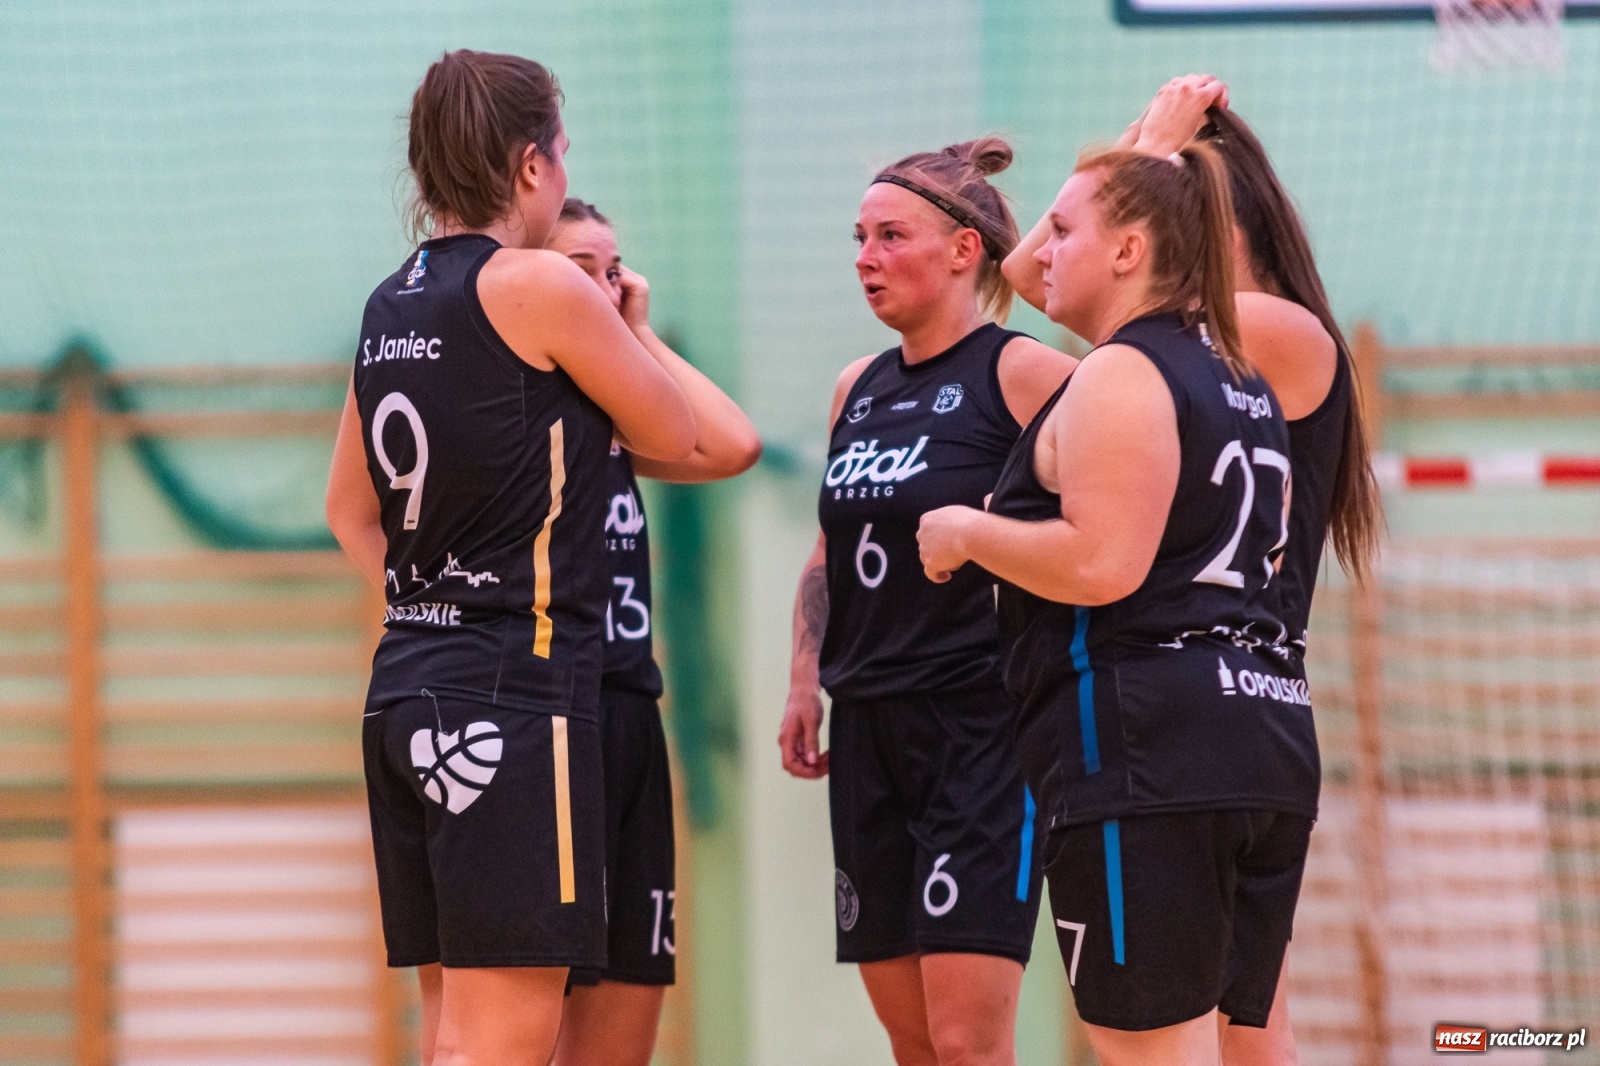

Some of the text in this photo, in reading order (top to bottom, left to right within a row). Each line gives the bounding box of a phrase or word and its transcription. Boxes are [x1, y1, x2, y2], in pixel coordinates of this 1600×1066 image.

[375, 330, 442, 362] Janiec
[940, 387, 962, 397] STAL
[371, 391, 429, 530] 9
[826, 436, 930, 487] Stal
[835, 486, 894, 500] BRZEG
[856, 523, 888, 588] 6
[924, 853, 959, 917] 6
